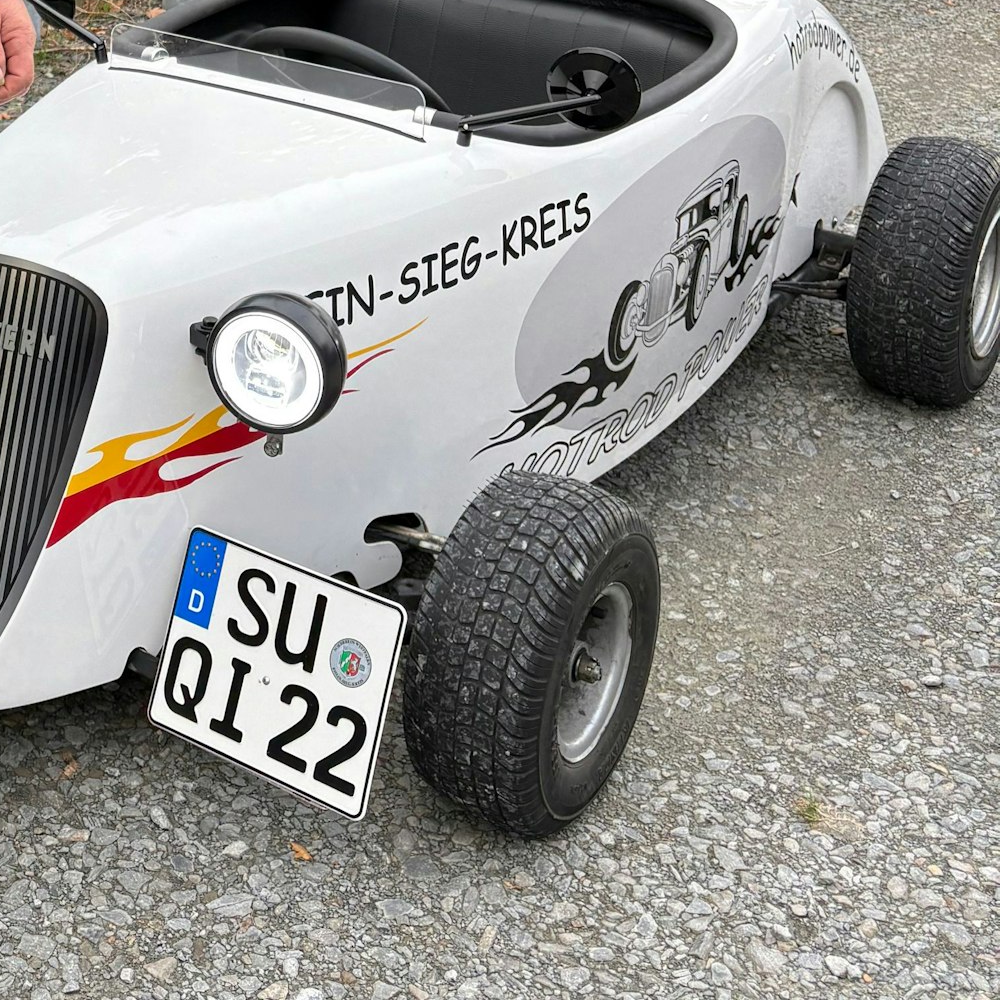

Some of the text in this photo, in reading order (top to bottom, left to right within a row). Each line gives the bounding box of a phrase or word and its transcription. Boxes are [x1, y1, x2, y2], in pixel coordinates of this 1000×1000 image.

[678, 273, 769, 402] POWER
[187, 588, 205, 613] D
[227, 567, 328, 673] SU
[164, 636, 367, 797] QI 22
